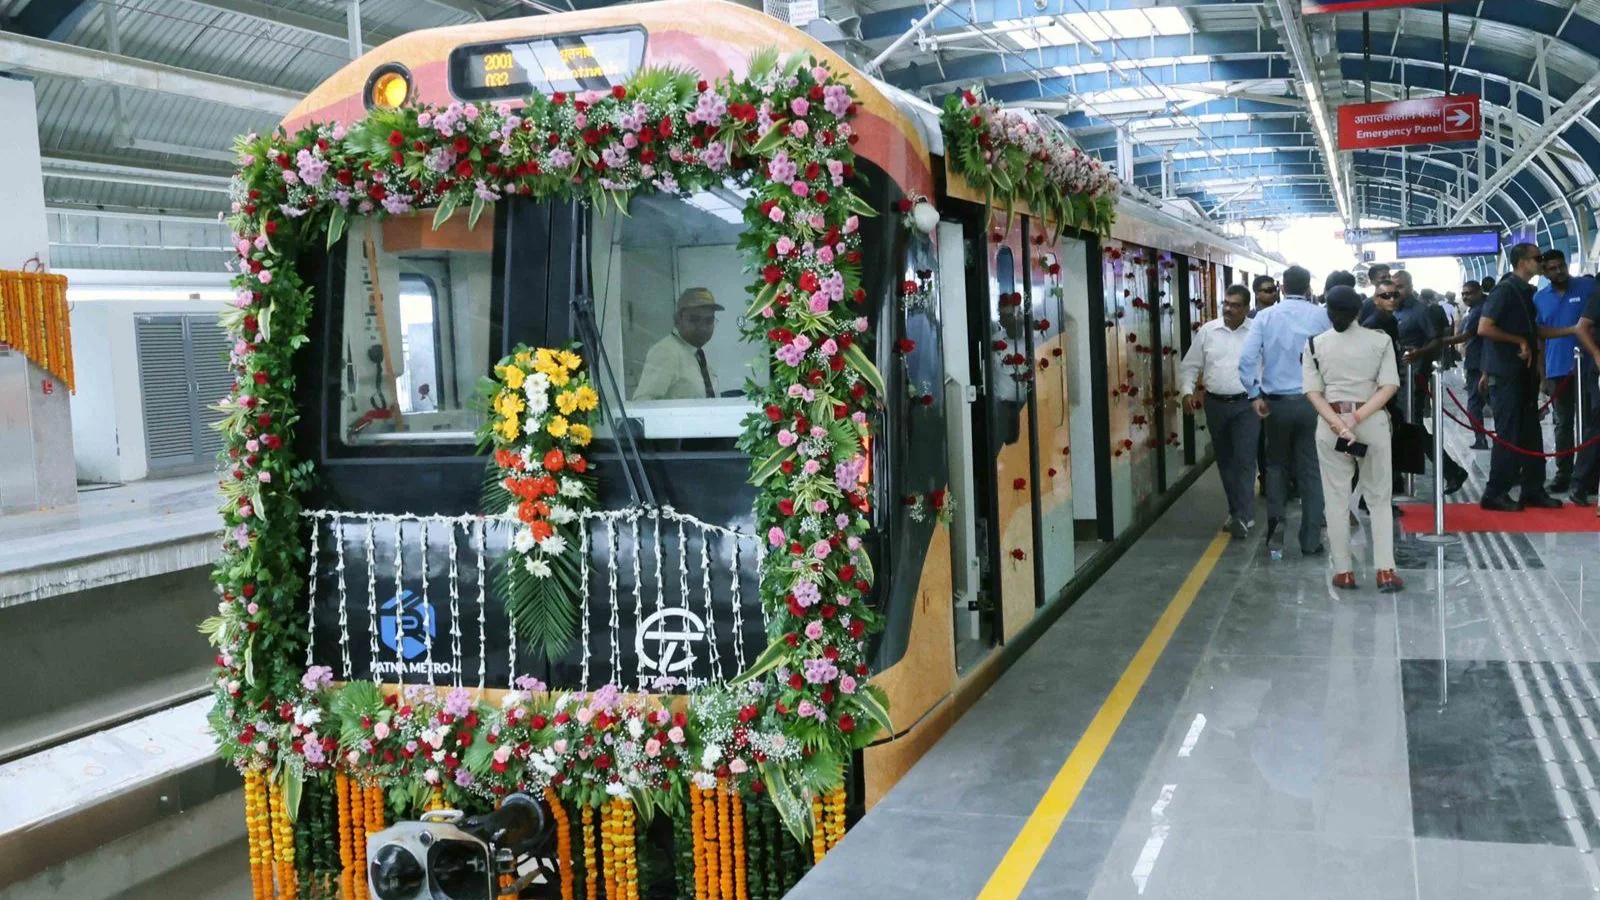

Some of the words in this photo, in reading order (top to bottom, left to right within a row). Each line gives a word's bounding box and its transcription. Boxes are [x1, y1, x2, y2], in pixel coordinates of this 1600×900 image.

[484, 52, 513, 71] 2001
[1356, 126, 1413, 139] Emergency
[1414, 123, 1442, 134] Panel
[409, 662, 451, 674] MERO
